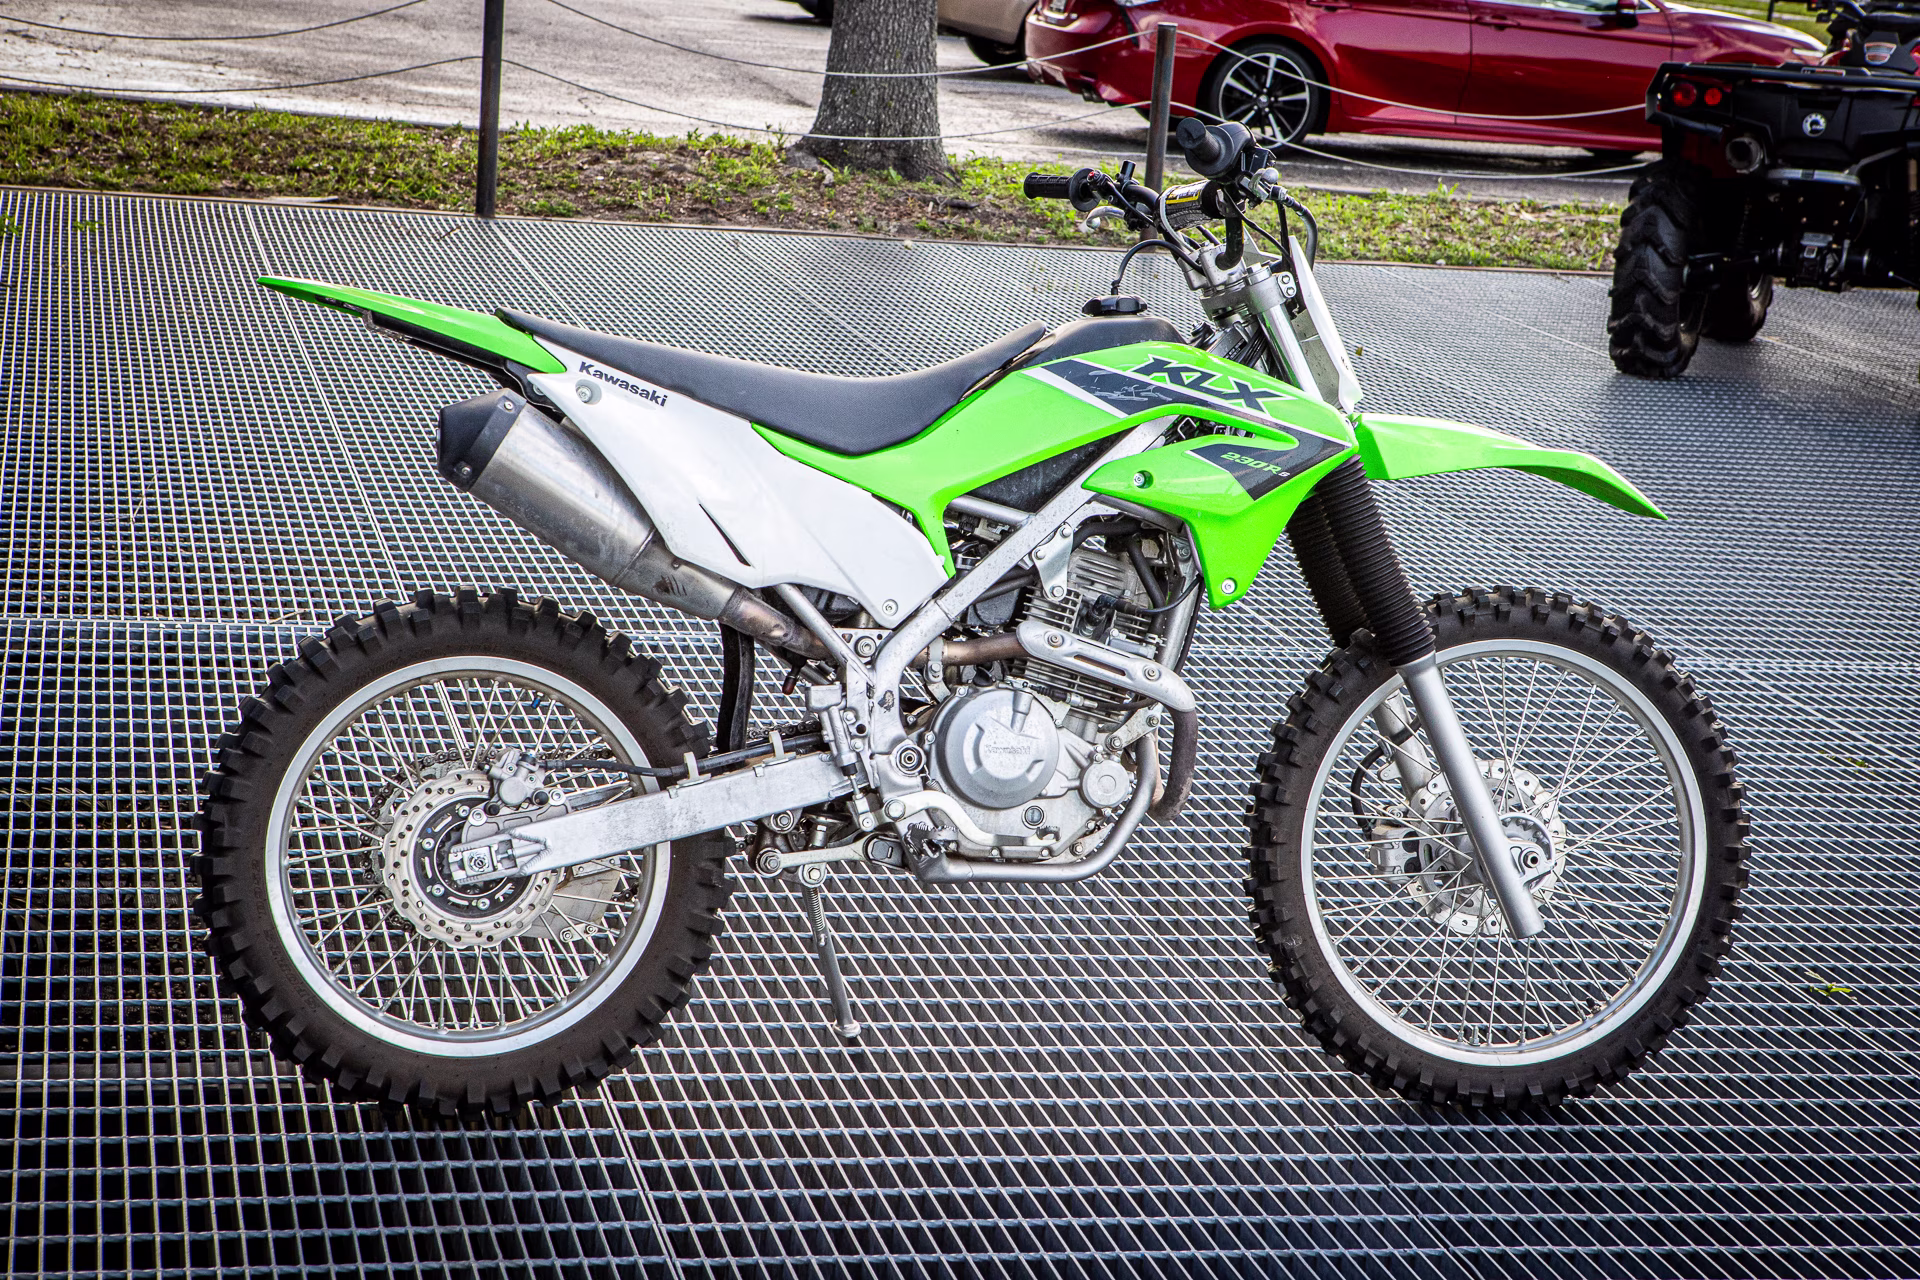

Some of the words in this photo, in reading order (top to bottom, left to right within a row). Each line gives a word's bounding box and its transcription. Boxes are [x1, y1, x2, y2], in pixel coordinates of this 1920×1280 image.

[579, 361, 668, 407] Kawasaki
[1127, 354, 1298, 417] KLX
[984, 744, 1031, 755] Kawasaki
